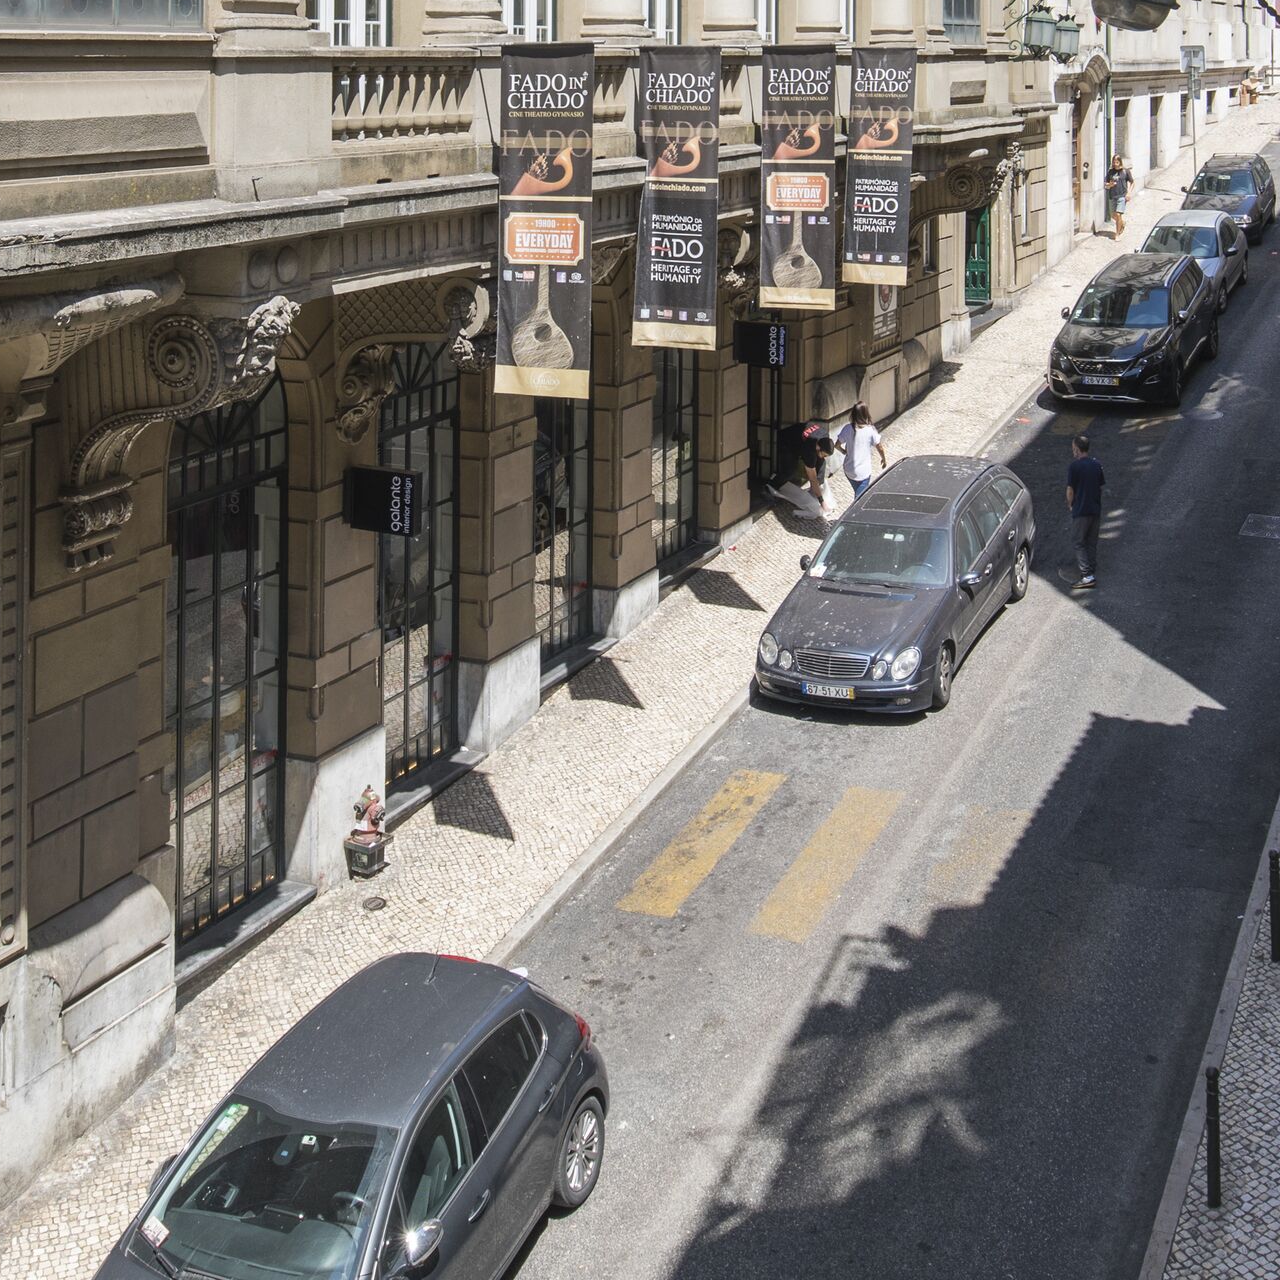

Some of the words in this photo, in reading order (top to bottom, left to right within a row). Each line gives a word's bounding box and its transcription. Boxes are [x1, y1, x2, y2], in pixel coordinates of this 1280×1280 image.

[647, 73, 695, 89] FADO
[697, 75, 711, 88] IN
[769, 68, 814, 82] FADO
[815, 70, 828, 80] IN
[856, 68, 897, 80] FADO
[897, 70, 909, 80] IN
[508, 73, 567, 92] FADO
[568, 76, 584, 90] IN
[767, 82, 829, 95] CHIADO
[854, 80, 909, 92] CHIADO
[507, 92, 585, 109] CHIADO
[645, 89, 711, 104] CHIADO
[763, 109, 834, 131] FADO
[850, 105, 913, 125] FADO
[640, 119, 717, 146] FADO
[502, 128, 593, 158] FADO
[855, 178, 891, 186] PATRIMÓNIO
[776, 187, 821, 199] EVERYDAY
[853, 196, 899, 214] FADO
[651, 214, 694, 224] PATRIMÓNIO
[651, 222, 702, 232] HUMANIDADE
[853, 217, 887, 225] HERITAGE
[853, 224, 896, 233] HUMANITY
[515, 232, 574, 249] EVERYDAY
[650, 237, 704, 259] FADO
[650, 263, 690, 274] HERITAGE
[650, 272, 702, 284] HUMANITY
[768, 326, 778, 365] galante
[403, 477, 413, 505] design
[389, 475, 403, 532] galante
[402, 506, 411, 534] interior
